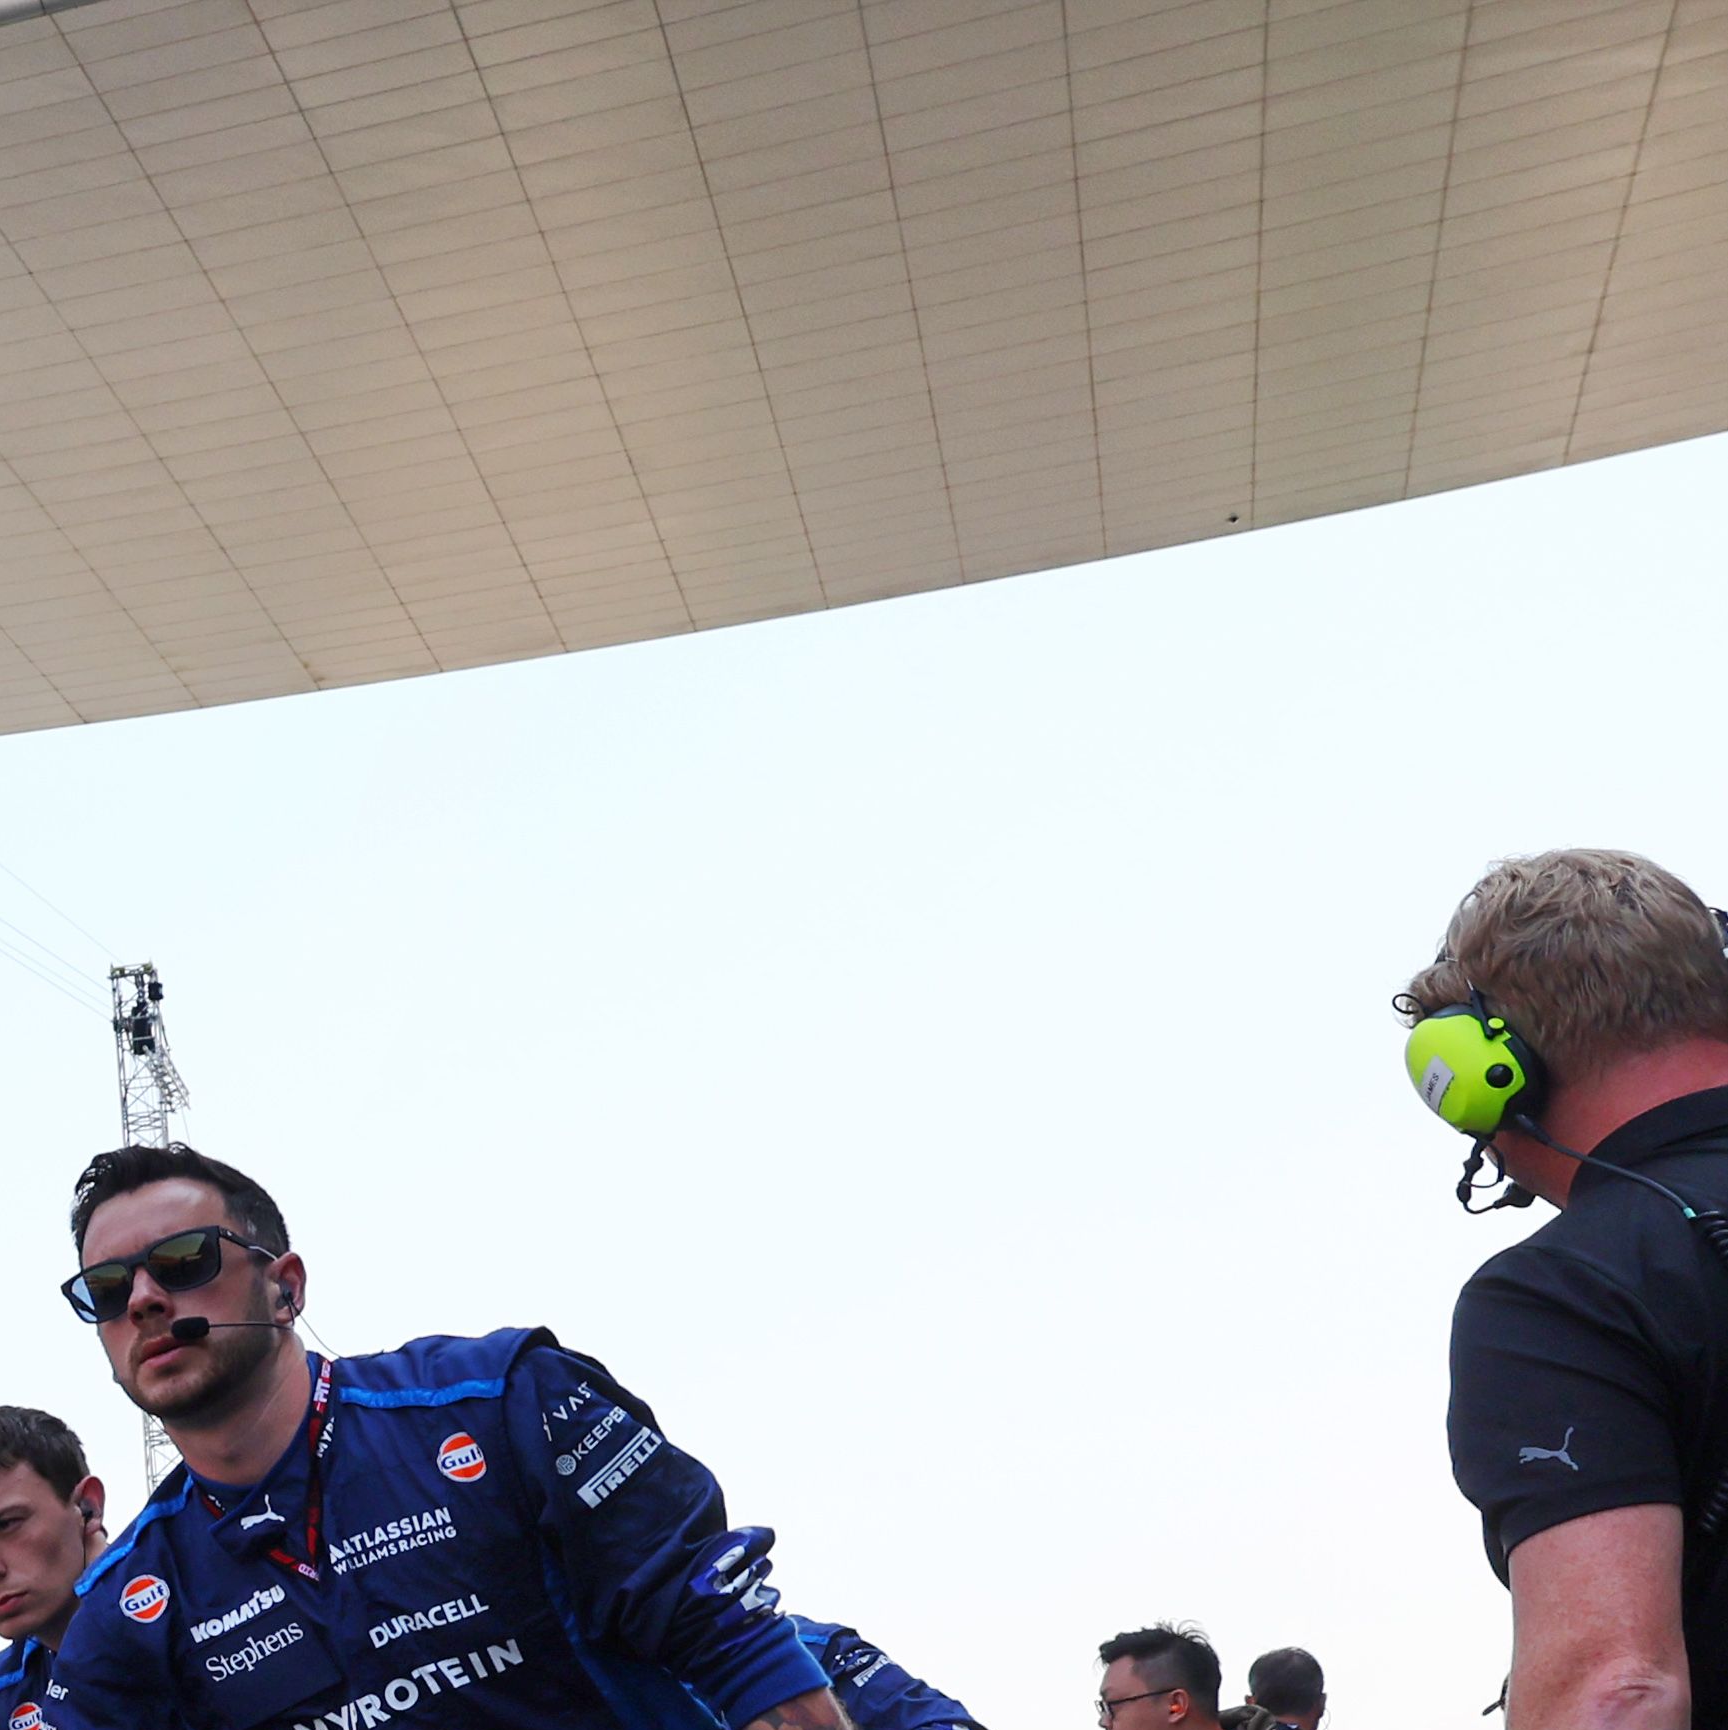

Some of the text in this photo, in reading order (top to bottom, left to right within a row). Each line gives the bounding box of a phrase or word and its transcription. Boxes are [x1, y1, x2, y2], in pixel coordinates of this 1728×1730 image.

[571, 1405, 628, 1461] KEEPER
[576, 1425, 663, 1510] PIRELLI
[333, 1543, 398, 1576] WILLIAMS
[399, 1525, 458, 1553] RACING
[341, 1506, 452, 1556] ATLASSIAN
[122, 1583, 168, 1620] Gulf
[189, 1583, 286, 1643] KOMATSU
[368, 1593, 490, 1650] DURACELL
[205, 1621, 305, 1684] Stephens
